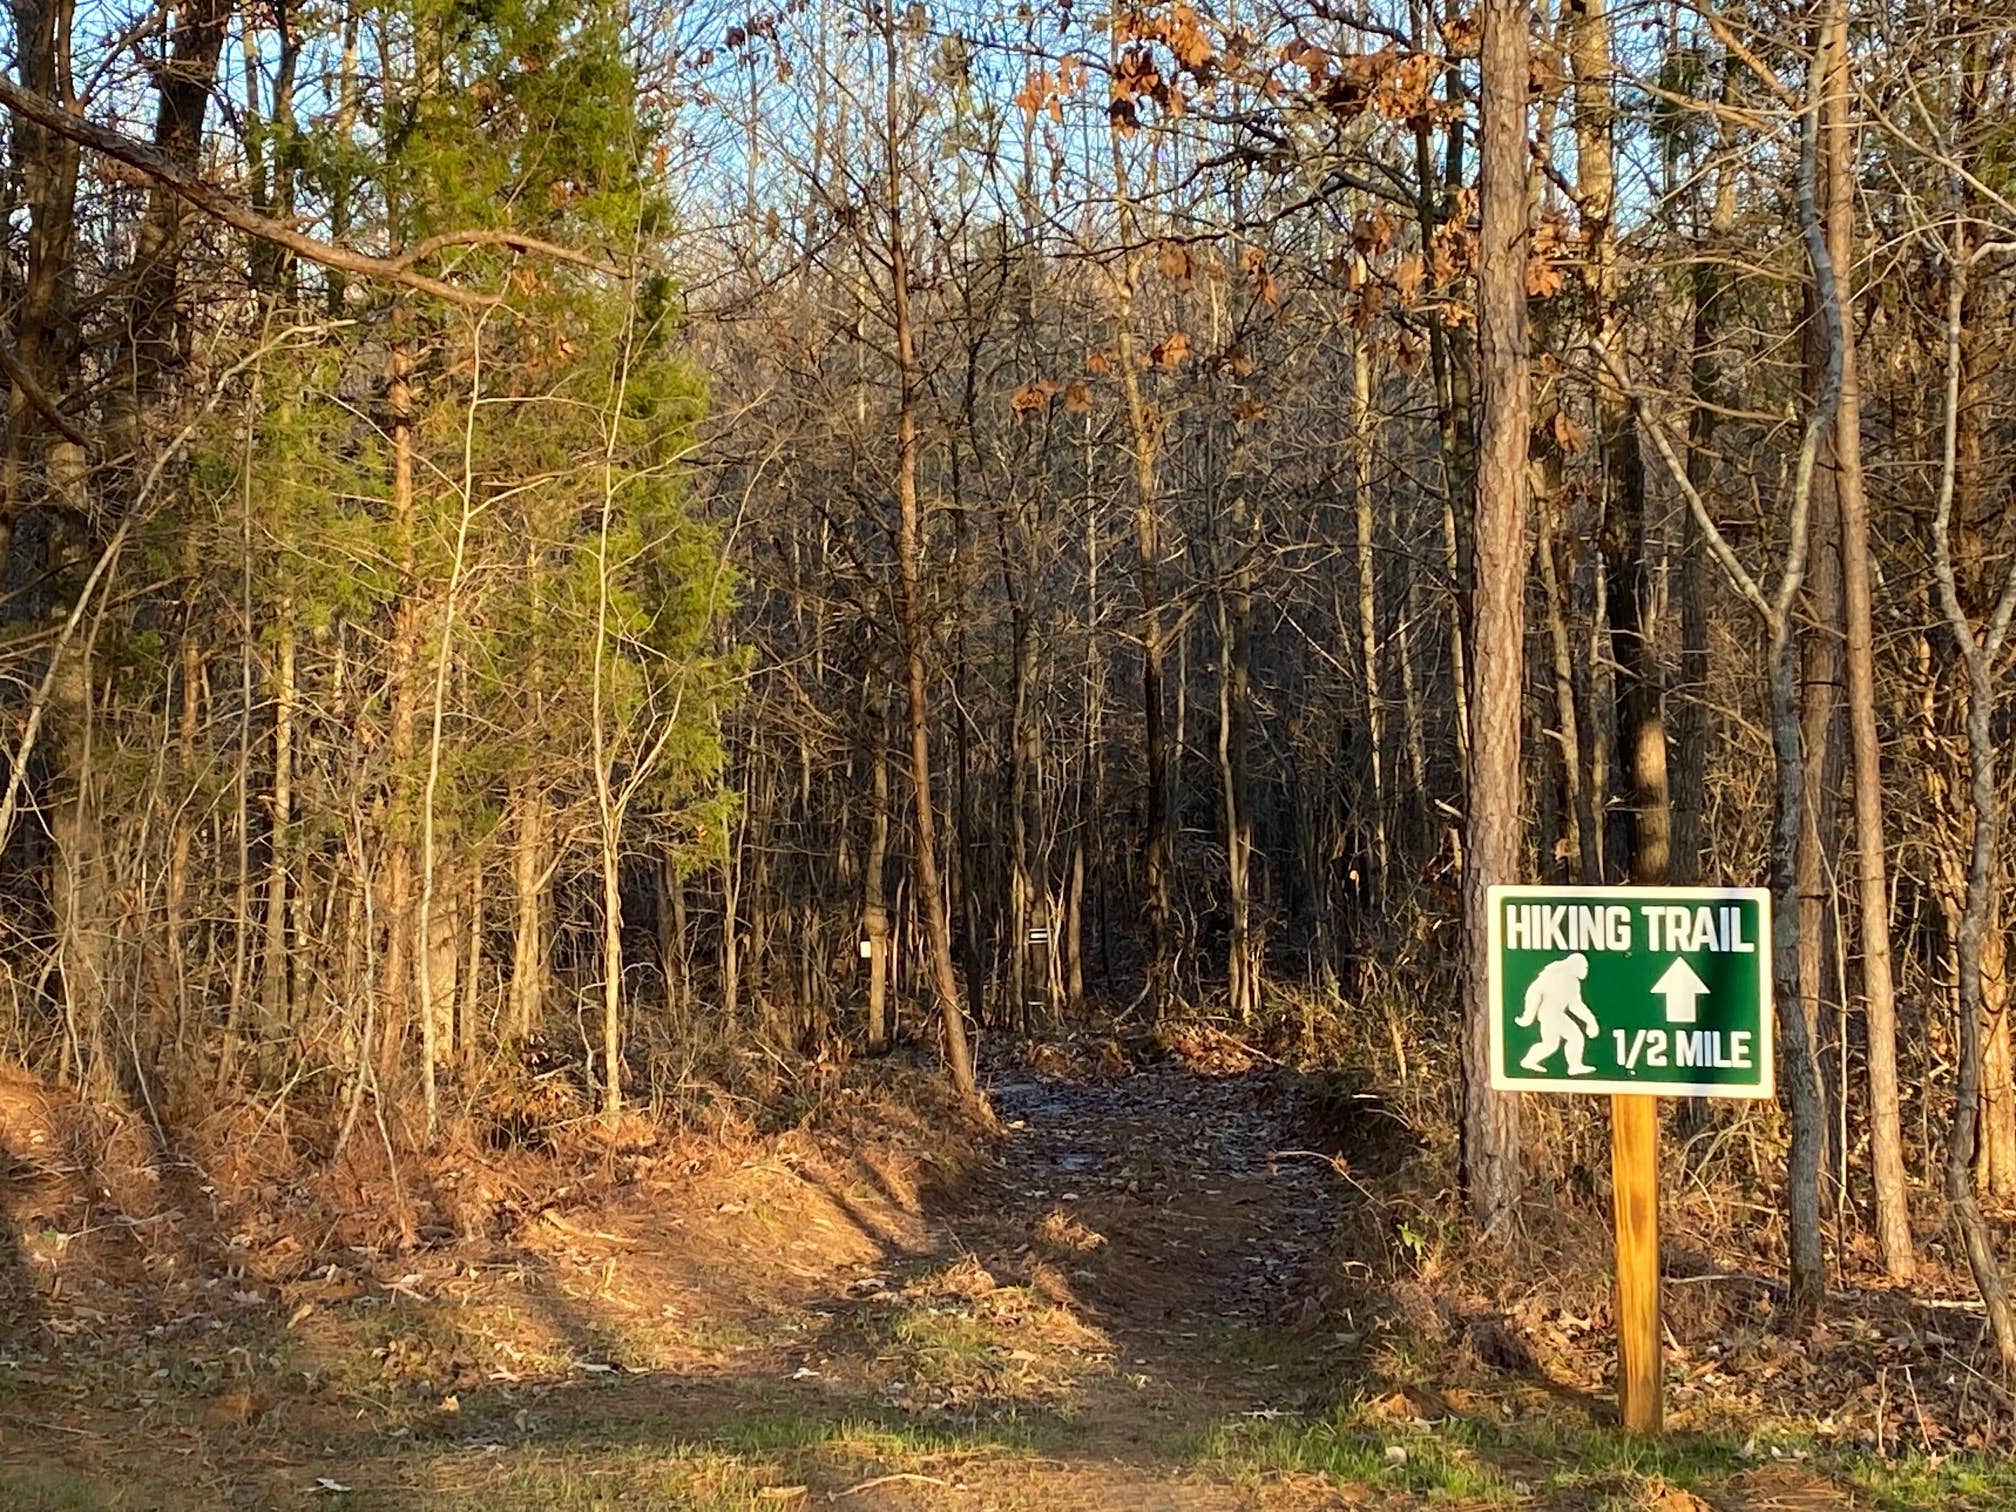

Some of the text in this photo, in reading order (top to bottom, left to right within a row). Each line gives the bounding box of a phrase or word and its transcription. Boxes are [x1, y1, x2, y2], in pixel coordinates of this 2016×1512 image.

[1506, 904, 1754, 952] HIKING TRAIL
[1613, 1029, 1752, 1069] 1/2 MILE
